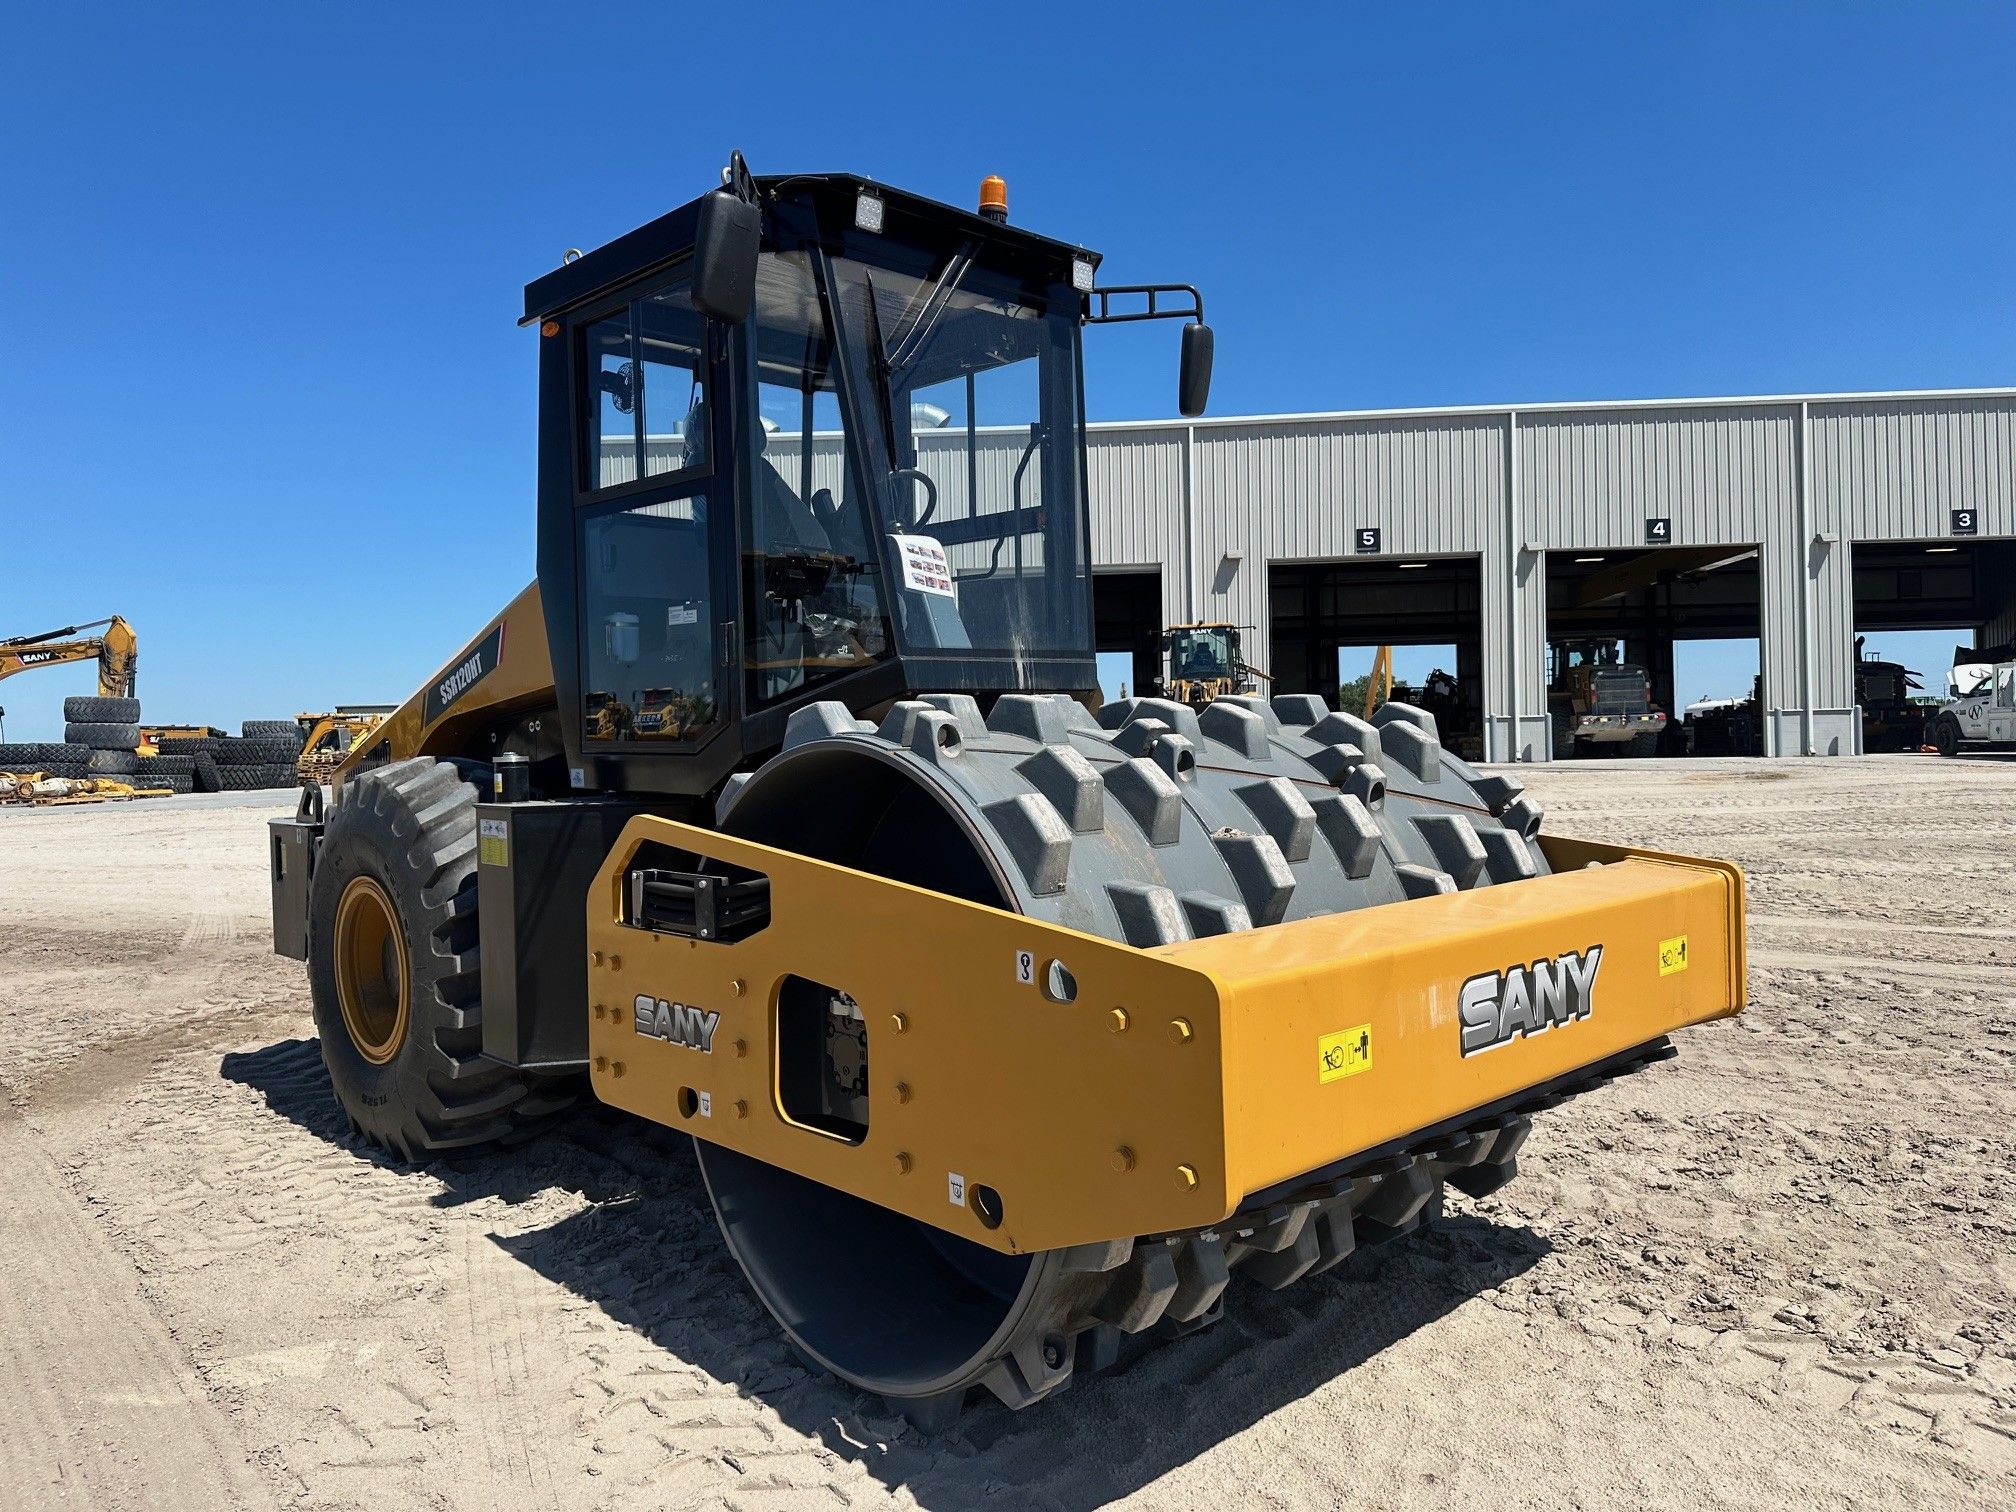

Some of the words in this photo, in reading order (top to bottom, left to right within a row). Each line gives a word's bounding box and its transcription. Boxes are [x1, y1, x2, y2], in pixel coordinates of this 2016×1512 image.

[1959, 512, 1971, 527] 3
[1652, 521, 1665, 536] 4
[1362, 531, 1375, 546] 5
[22, 651, 51, 663] SANY
[1459, 944, 1604, 1060] SANY
[634, 993, 721, 1055] SANY
